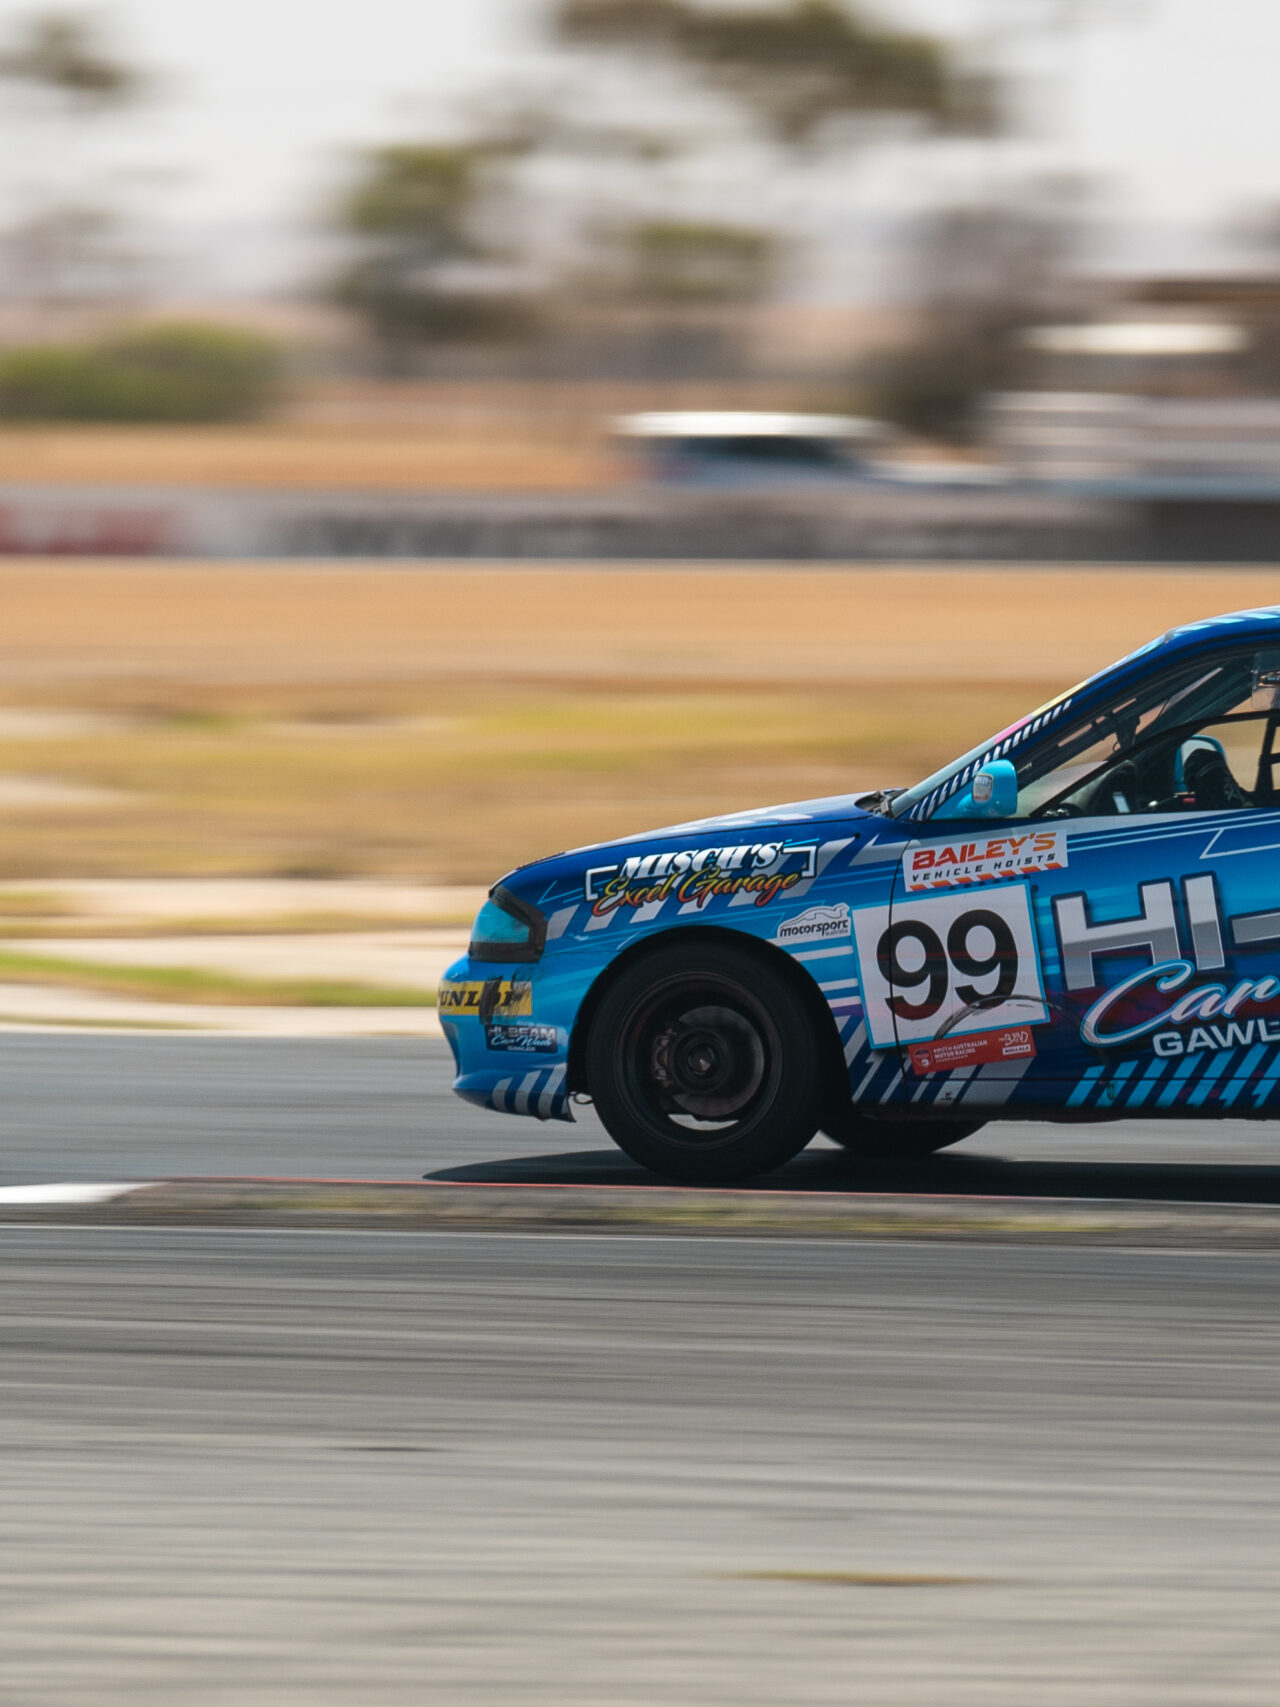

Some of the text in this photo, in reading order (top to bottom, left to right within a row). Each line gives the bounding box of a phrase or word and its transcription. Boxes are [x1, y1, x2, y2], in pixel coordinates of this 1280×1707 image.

[619, 841, 784, 880] MISCH'S
[912, 832, 1057, 871] BAILEY'S
[912, 853, 1056, 882] VEHICLE HOISTS
[592, 865, 800, 917] Excel Garage
[779, 920, 849, 938] motorsport
[876, 909, 1019, 1021] 99
[934, 1050, 954, 1060] MOTOR
[952, 1040, 988, 1050] AUSTRALIAN
